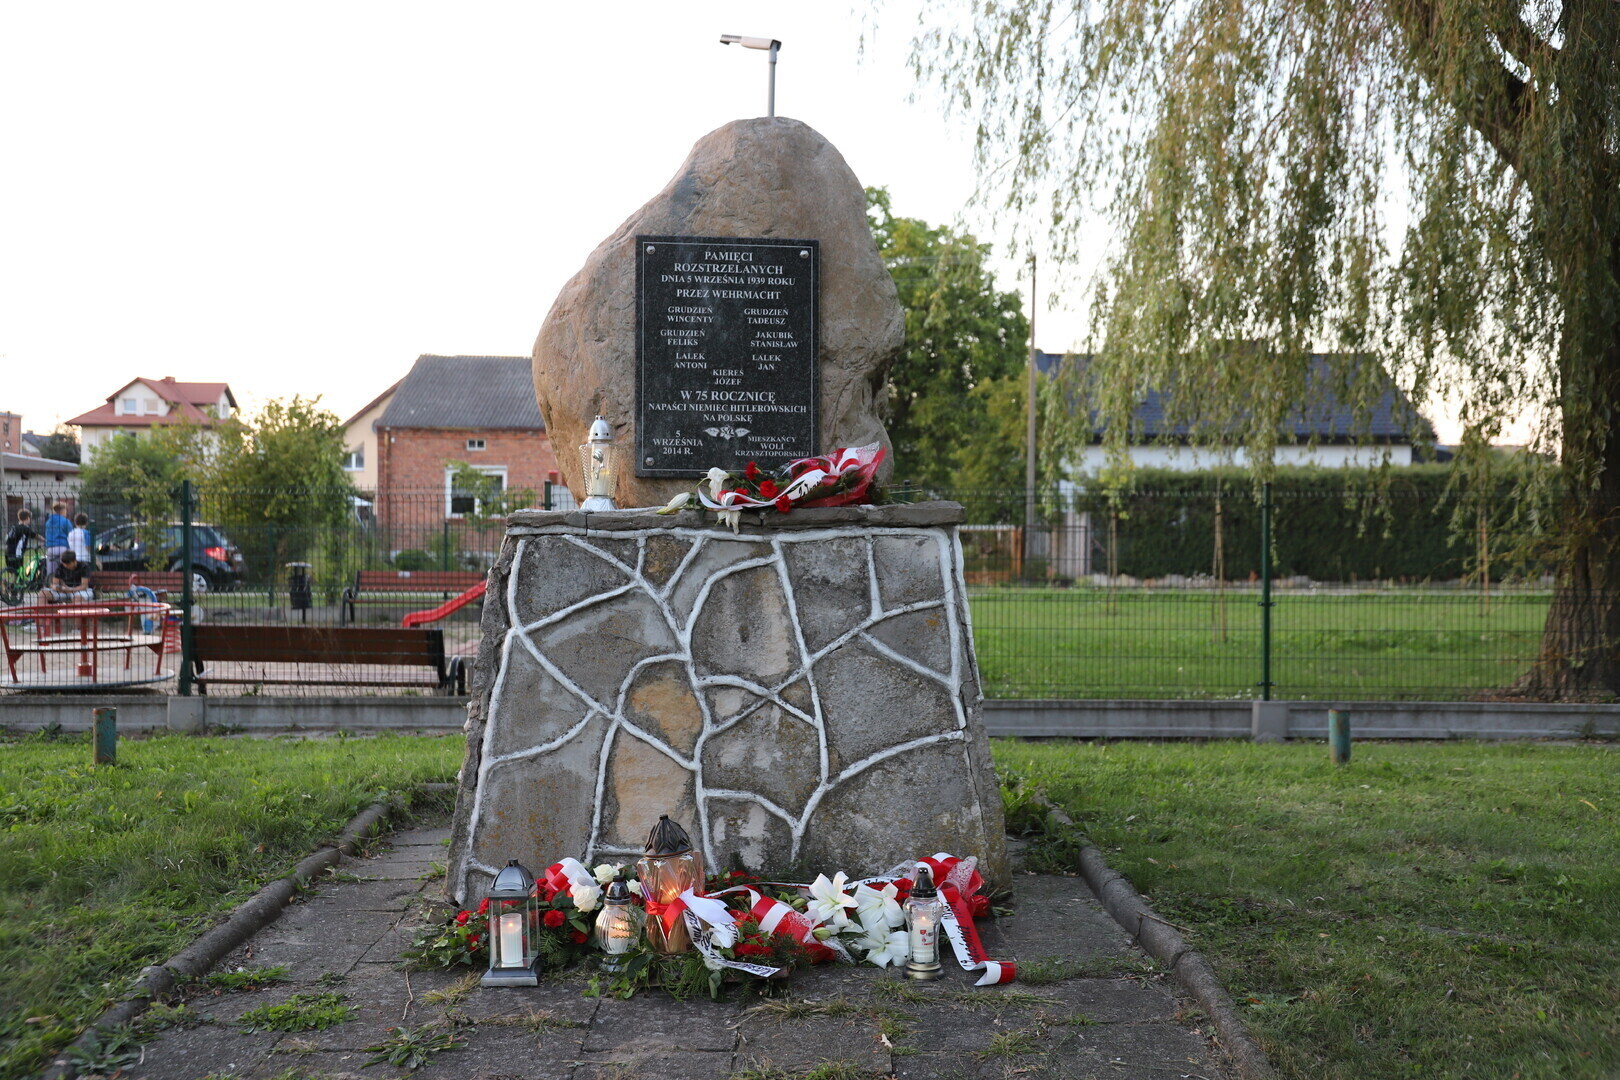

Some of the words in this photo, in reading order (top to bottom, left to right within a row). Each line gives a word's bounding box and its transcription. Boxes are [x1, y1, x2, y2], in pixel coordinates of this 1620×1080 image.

[704, 252, 753, 264] PAMIĘCI
[674, 263, 783, 274] ROZSTRZELANYCH
[661, 274, 685, 283] DNIA
[687, 275, 692, 283] 5
[695, 275, 744, 284] WRZEŚNIA
[747, 277, 765, 285] 1939
[768, 277, 796, 286] ROKU
[676, 289, 710, 298] PRZEZ
[712, 290, 782, 299] WEHRMACHT
[667, 306, 713, 314] GRUDZIEŃ
[744, 306, 789, 316] GRUDZIEŃ
[667, 315, 714, 323] WINCENTY
[747, 317, 786, 325] TADEUSZ
[660, 329, 706, 337] GRUDZIEŃ
[750, 340, 799, 348] STANISŁAW
[758, 363, 775, 371] JAN
[714, 377, 743, 385] JÓZEF
[681, 390, 693, 399] W
[696, 390, 708, 401] 75
[711, 391, 776, 404] ROCZNICĘ
[648, 401, 687, 411] NAPAŚCI
[689, 404, 728, 412] NIEMIEC
[730, 404, 807, 413] HITLEROWSKICH
[718, 414, 753, 424] POLSKĘ
[653, 437, 704, 447] WRZEŚNIA
[663, 447, 682, 455] 2014
